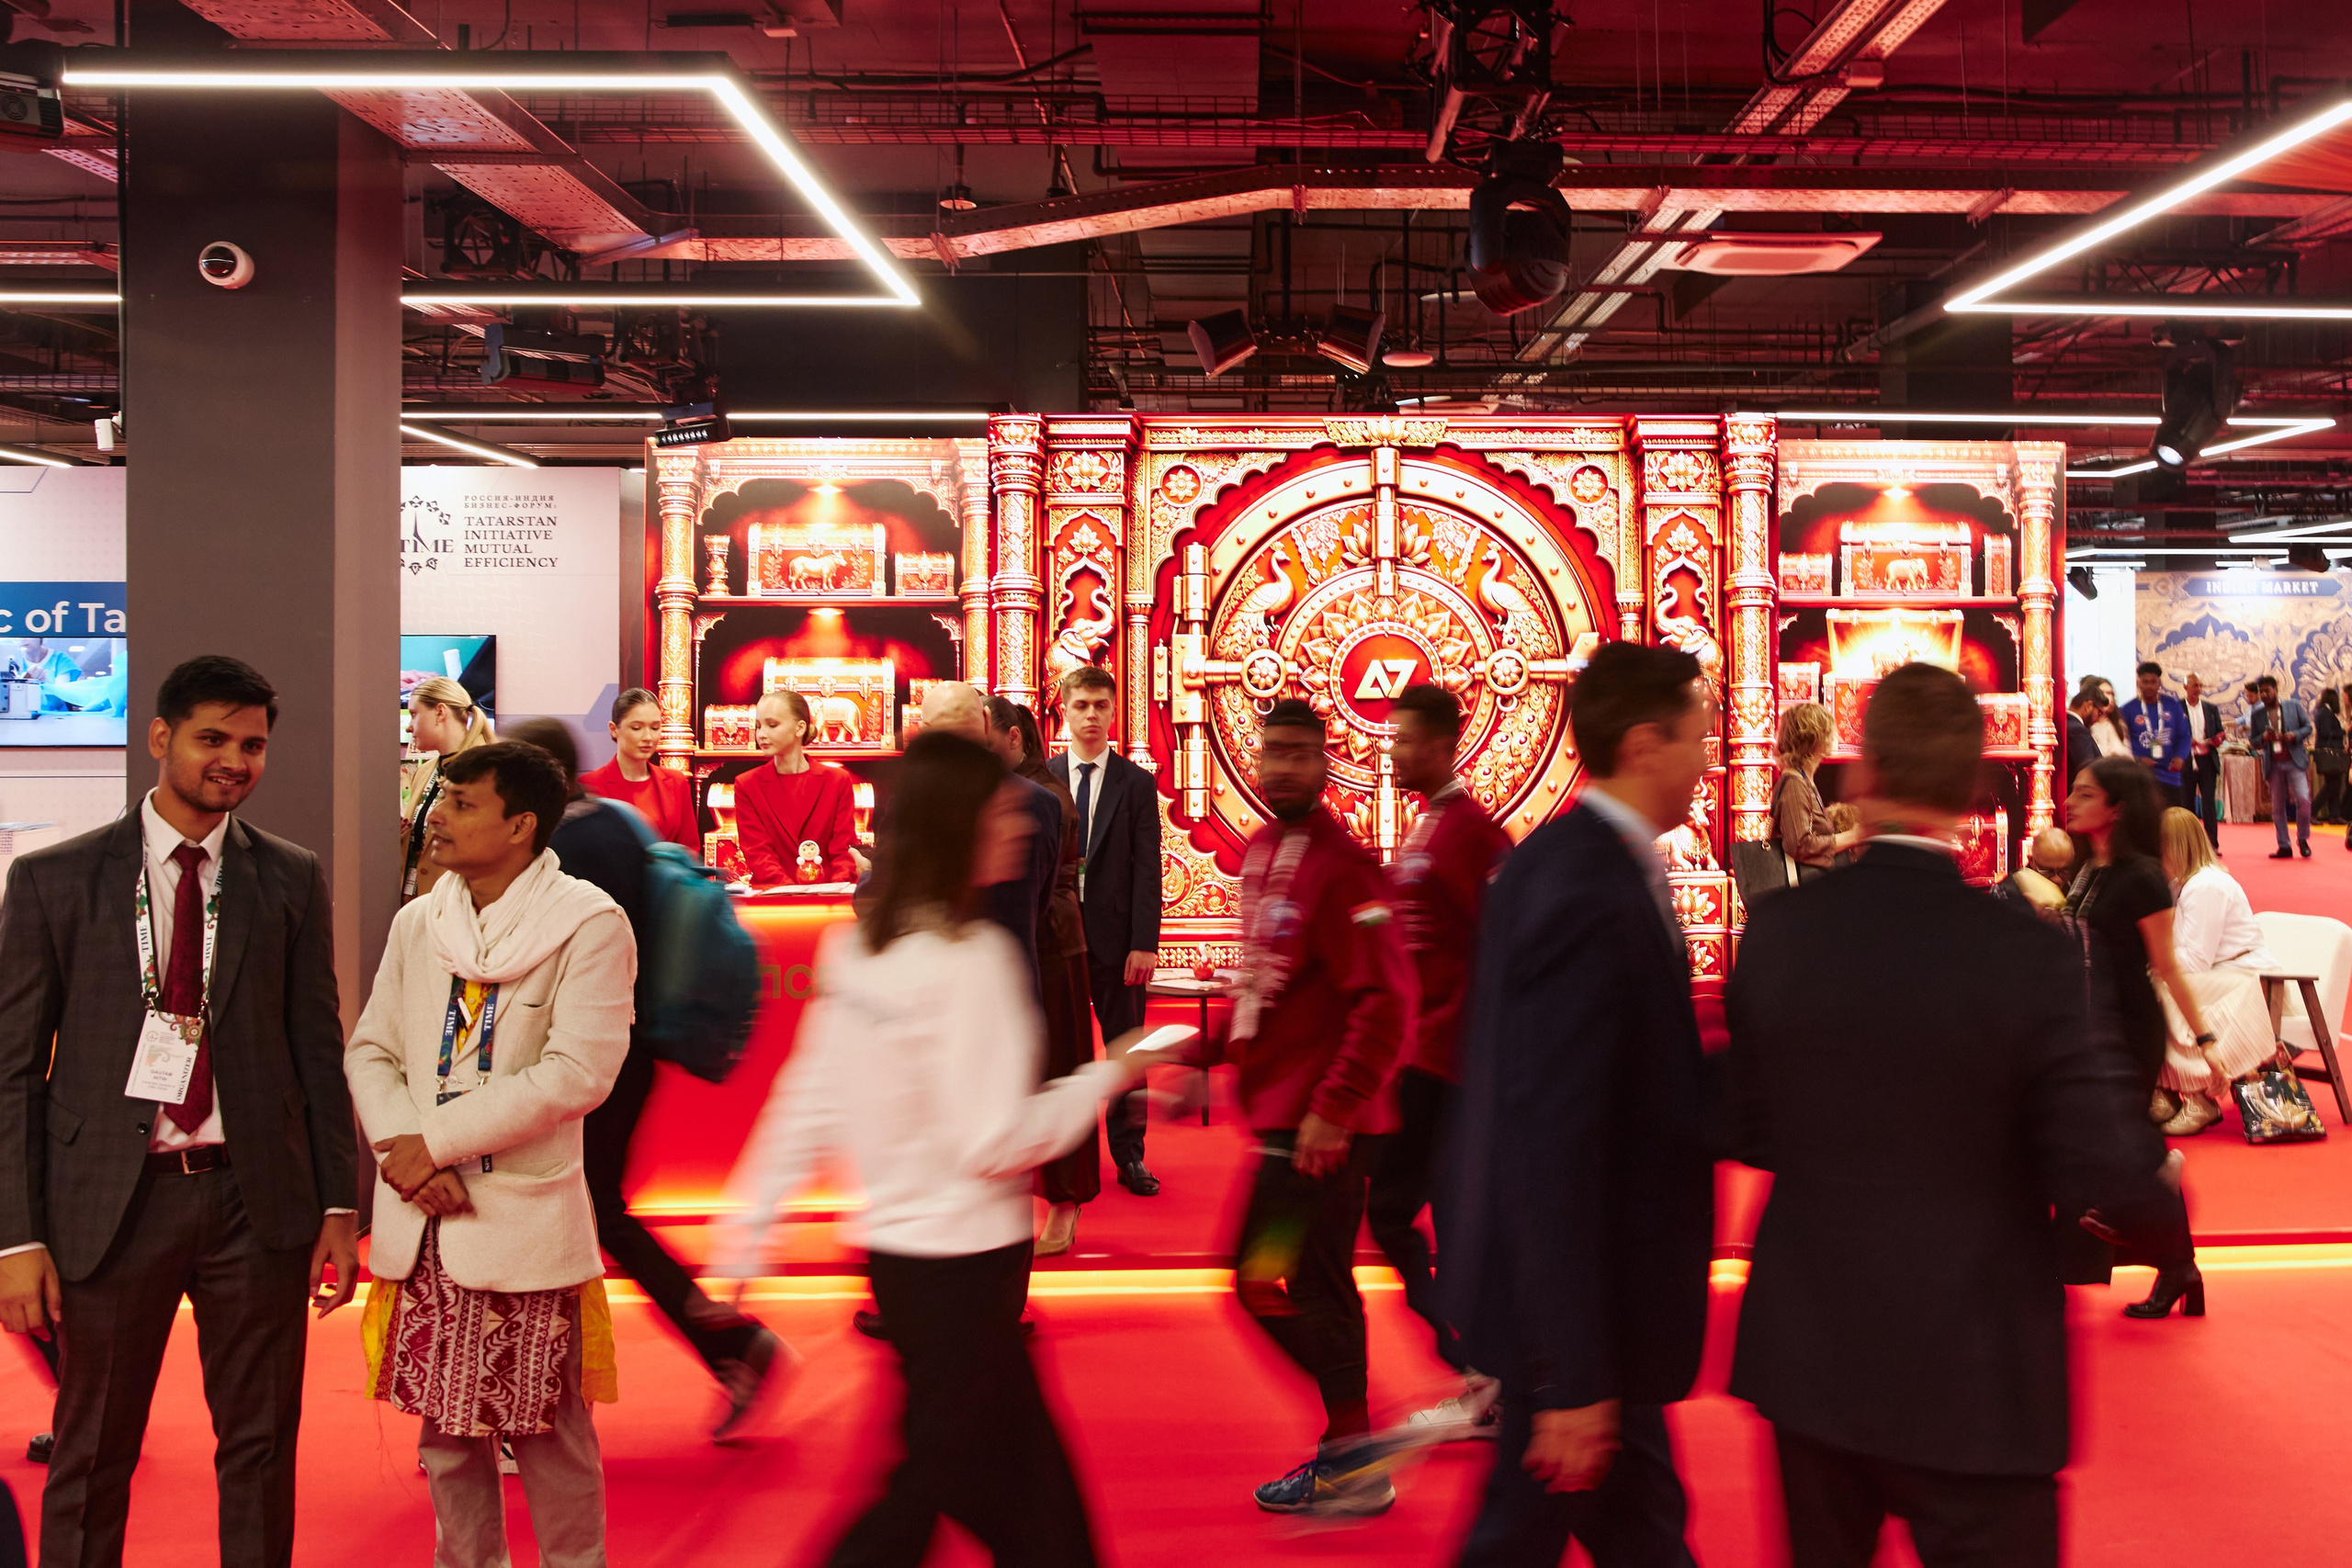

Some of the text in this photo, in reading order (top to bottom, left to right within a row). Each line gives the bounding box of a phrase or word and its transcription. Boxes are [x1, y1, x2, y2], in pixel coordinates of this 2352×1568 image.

[464, 516, 558, 526] TATARSTAN
[464, 530, 553, 540] INITIATIVE
[464, 544, 533, 554] MUTUAL
[464, 558, 559, 568] EFFICIENCY
[2261, 581, 2319, 594] MARKET
[25, 601, 70, 633] of
[1354, 660, 1418, 698] A7
[445, 1010, 457, 1036] TIME
[484, 1003, 494, 1031] TIME
[176, 1056, 193, 1100] ORGANIZER
